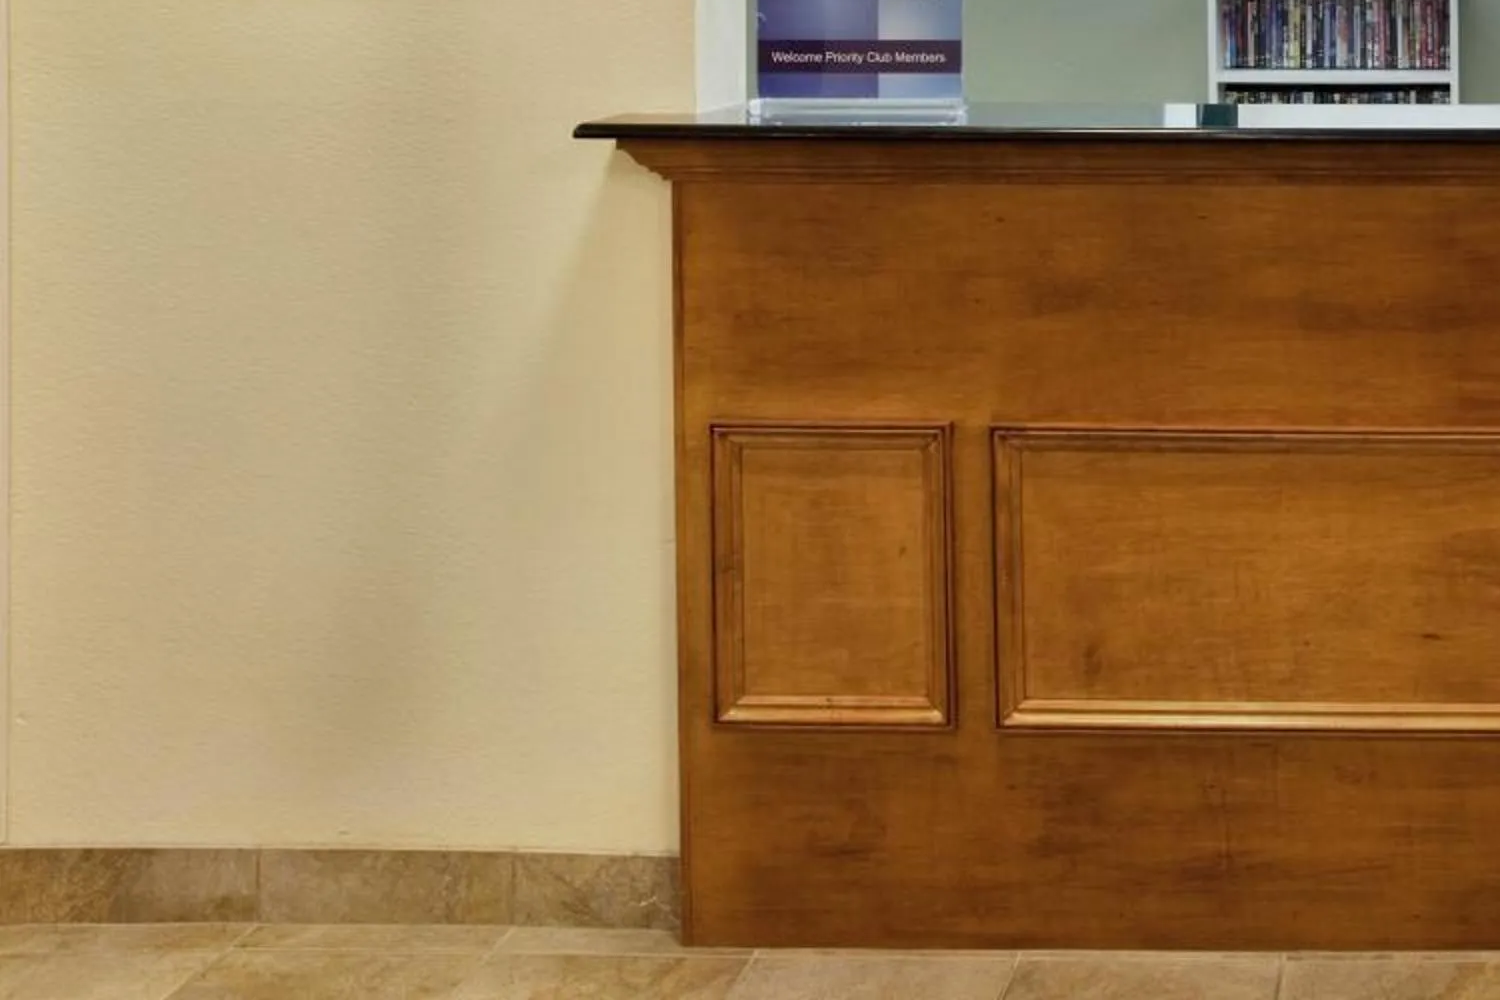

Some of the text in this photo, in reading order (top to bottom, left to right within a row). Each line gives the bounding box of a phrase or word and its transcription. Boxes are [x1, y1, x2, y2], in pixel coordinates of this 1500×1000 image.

[771, 51, 946, 65] Welcome Priority Club Members
